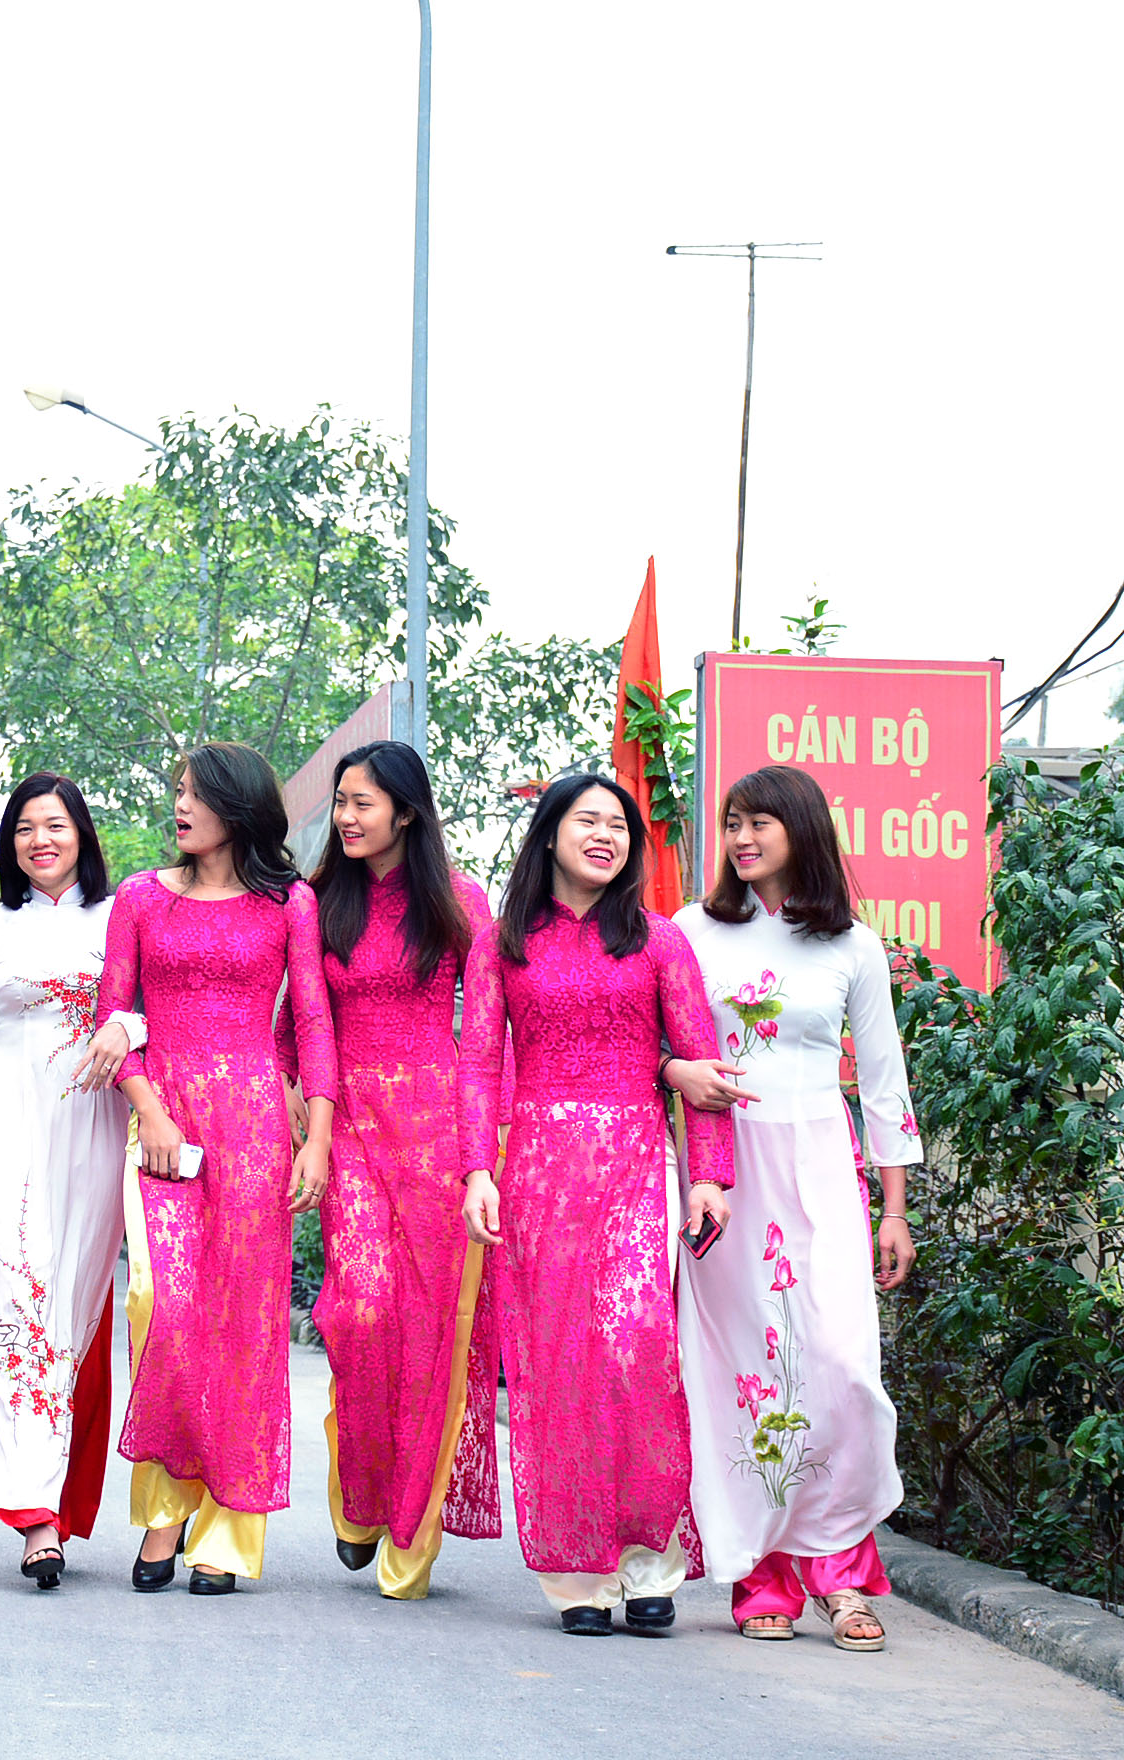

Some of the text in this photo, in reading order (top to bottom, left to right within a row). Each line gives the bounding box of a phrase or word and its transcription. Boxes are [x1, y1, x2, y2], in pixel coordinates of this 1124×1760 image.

[767, 704, 929, 777] CÁN BỘ
[829, 792, 969, 860] ÁI GỐC
